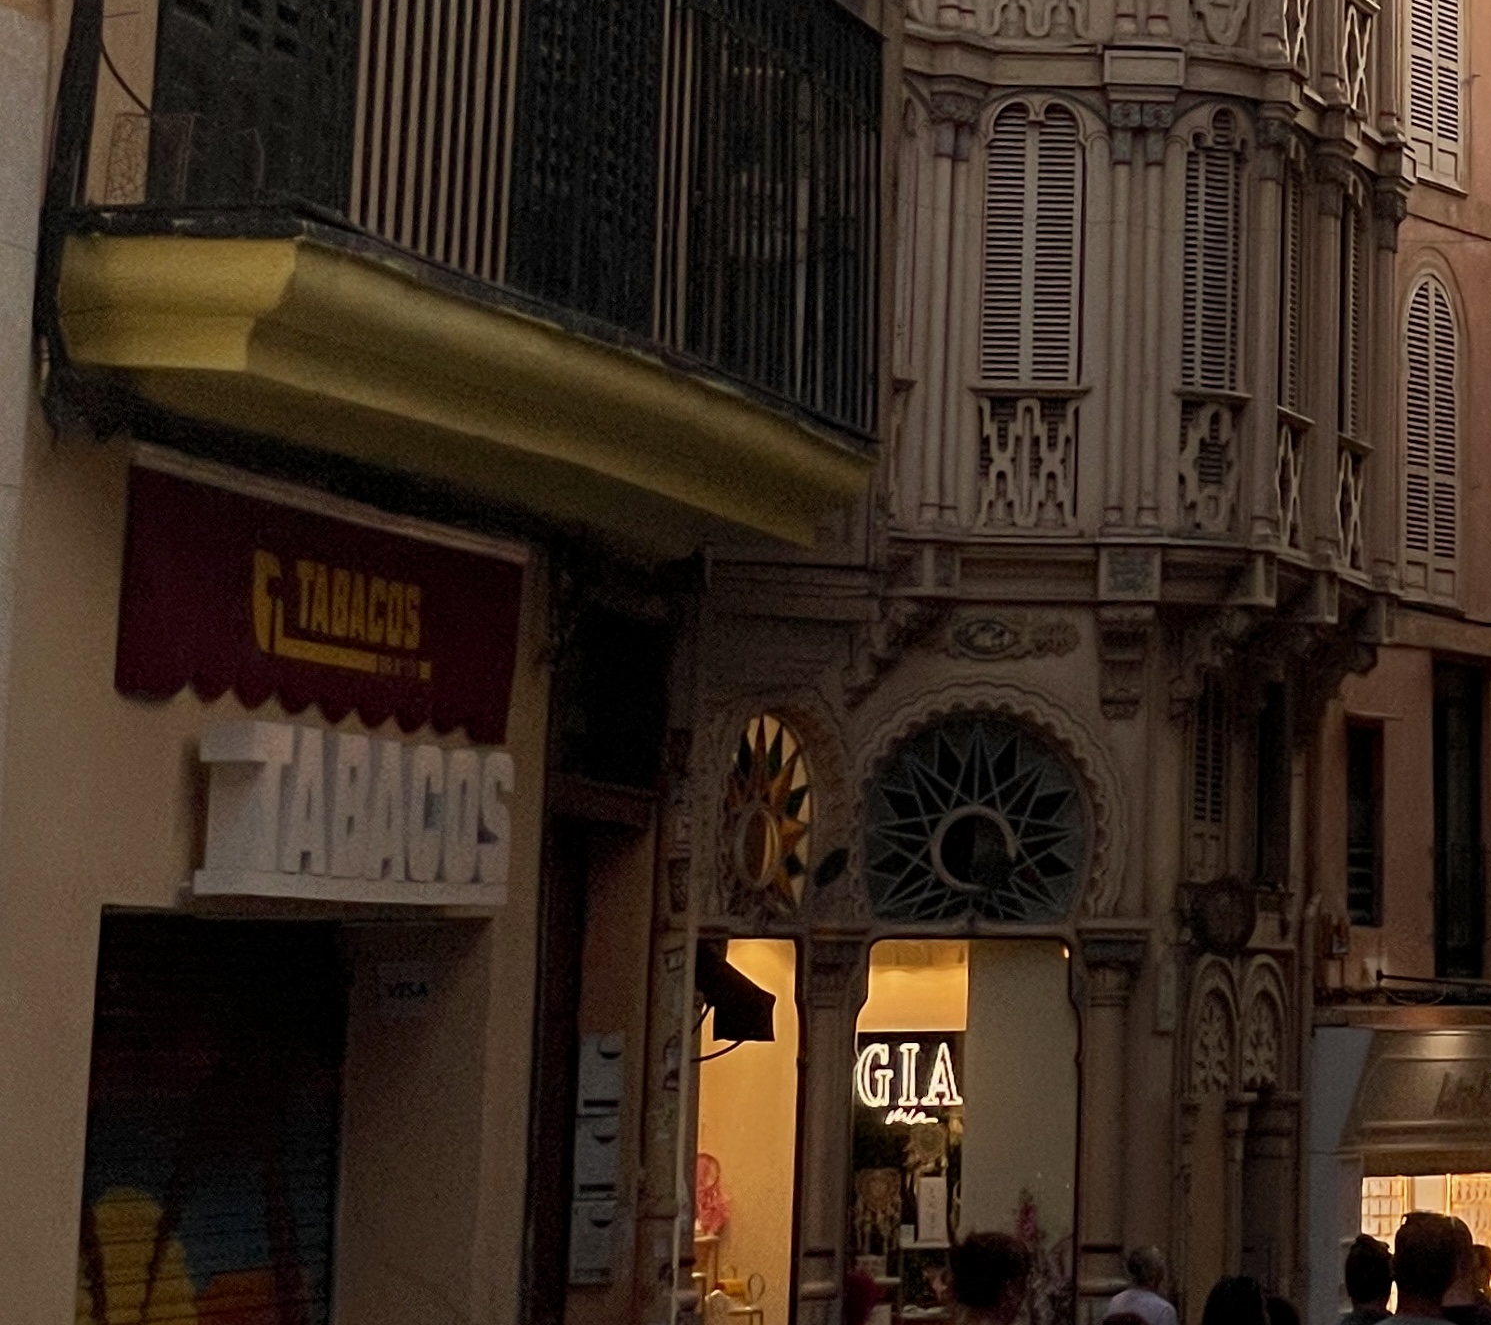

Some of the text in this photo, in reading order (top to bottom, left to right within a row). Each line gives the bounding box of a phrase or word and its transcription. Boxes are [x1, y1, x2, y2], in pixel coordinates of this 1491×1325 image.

[294, 558, 421, 651] TABACOS
[238, 720, 514, 884] TABACOS
[857, 1042, 964, 1108] GIA
